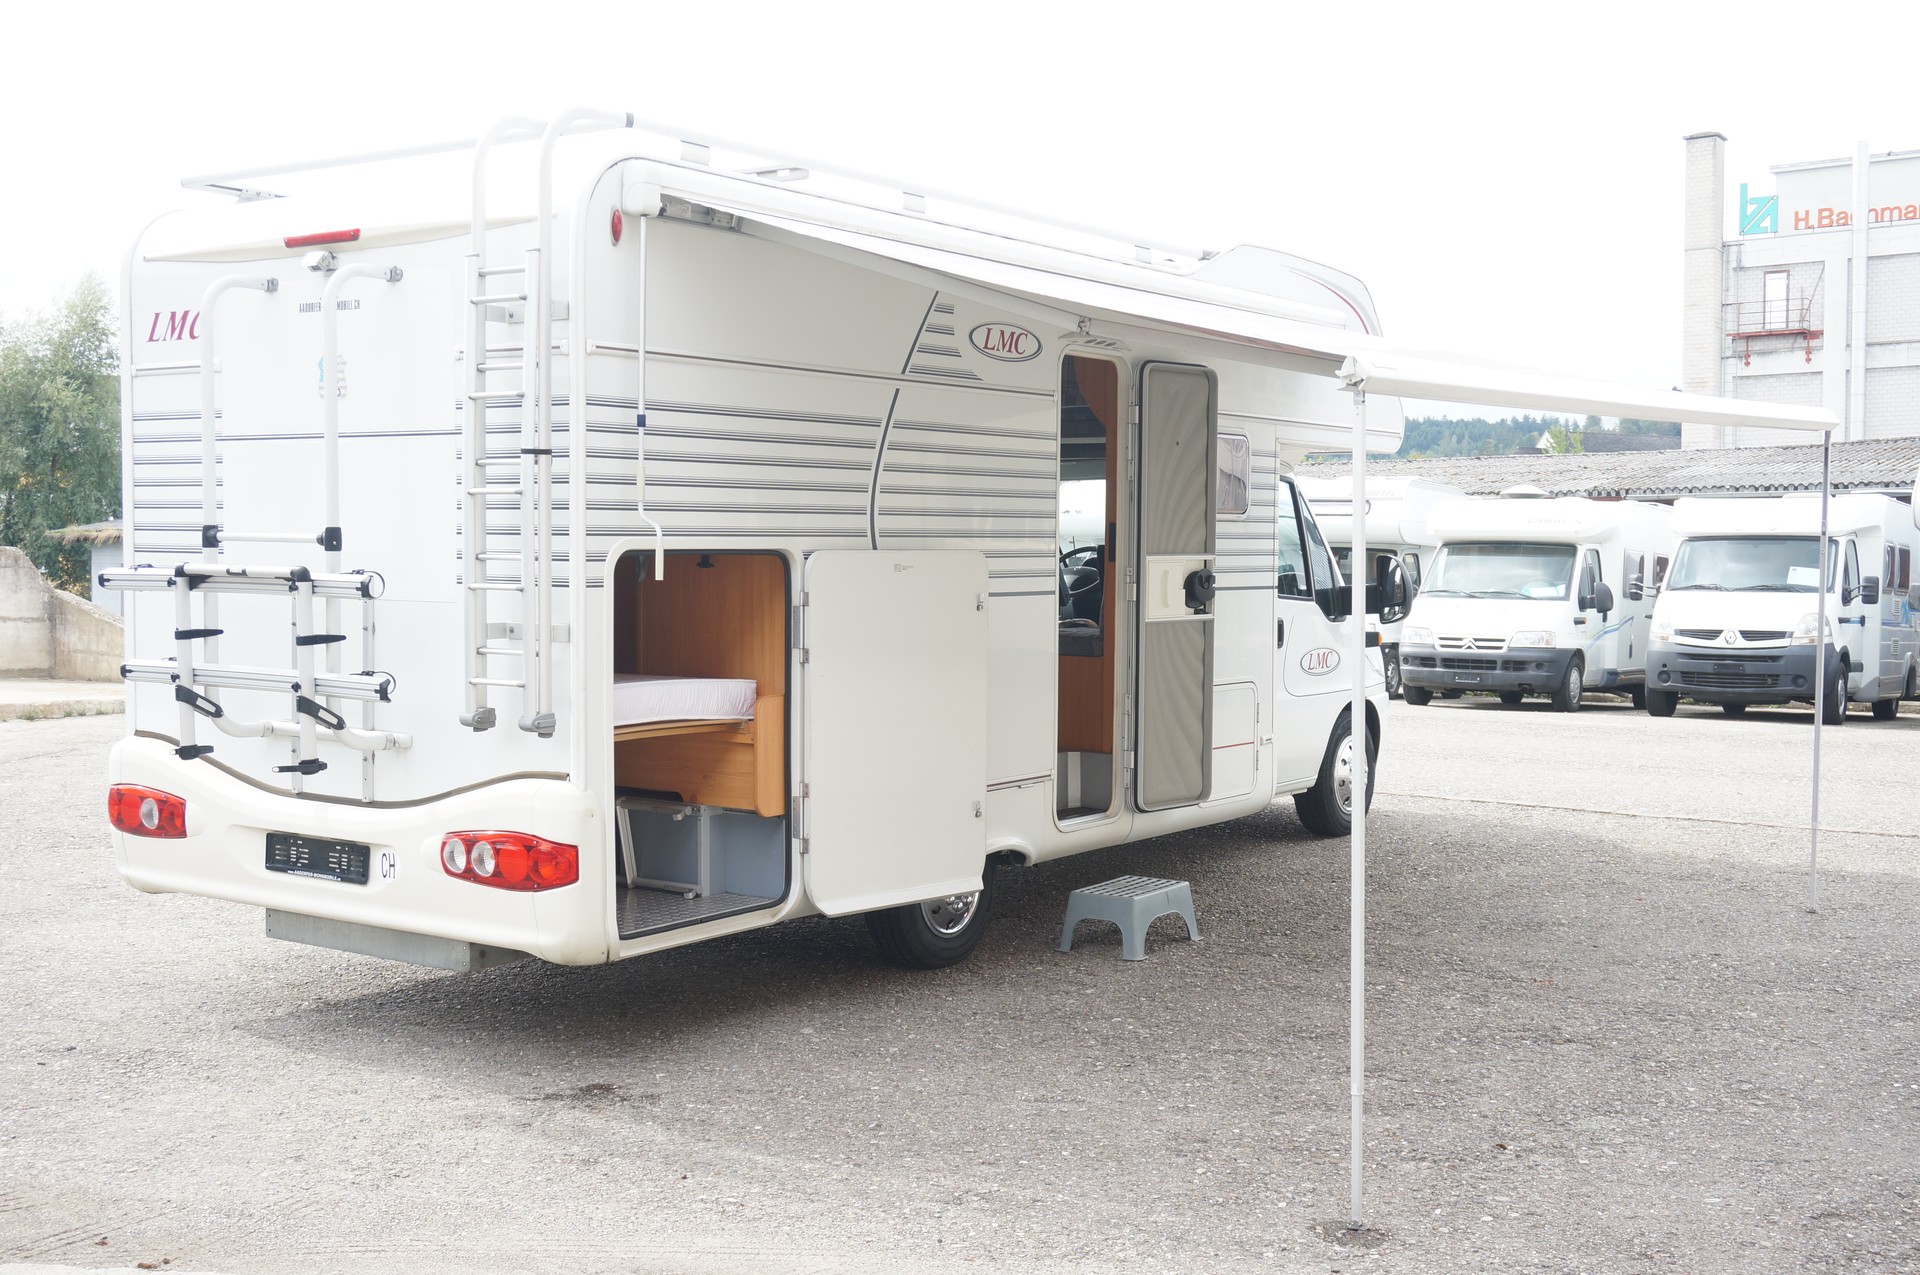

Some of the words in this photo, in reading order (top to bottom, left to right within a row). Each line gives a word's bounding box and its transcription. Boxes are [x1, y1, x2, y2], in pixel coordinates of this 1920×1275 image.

[983, 327, 1028, 355] LMC
[1308, 651, 1333, 670] LMC
[381, 852, 396, 879] CH
